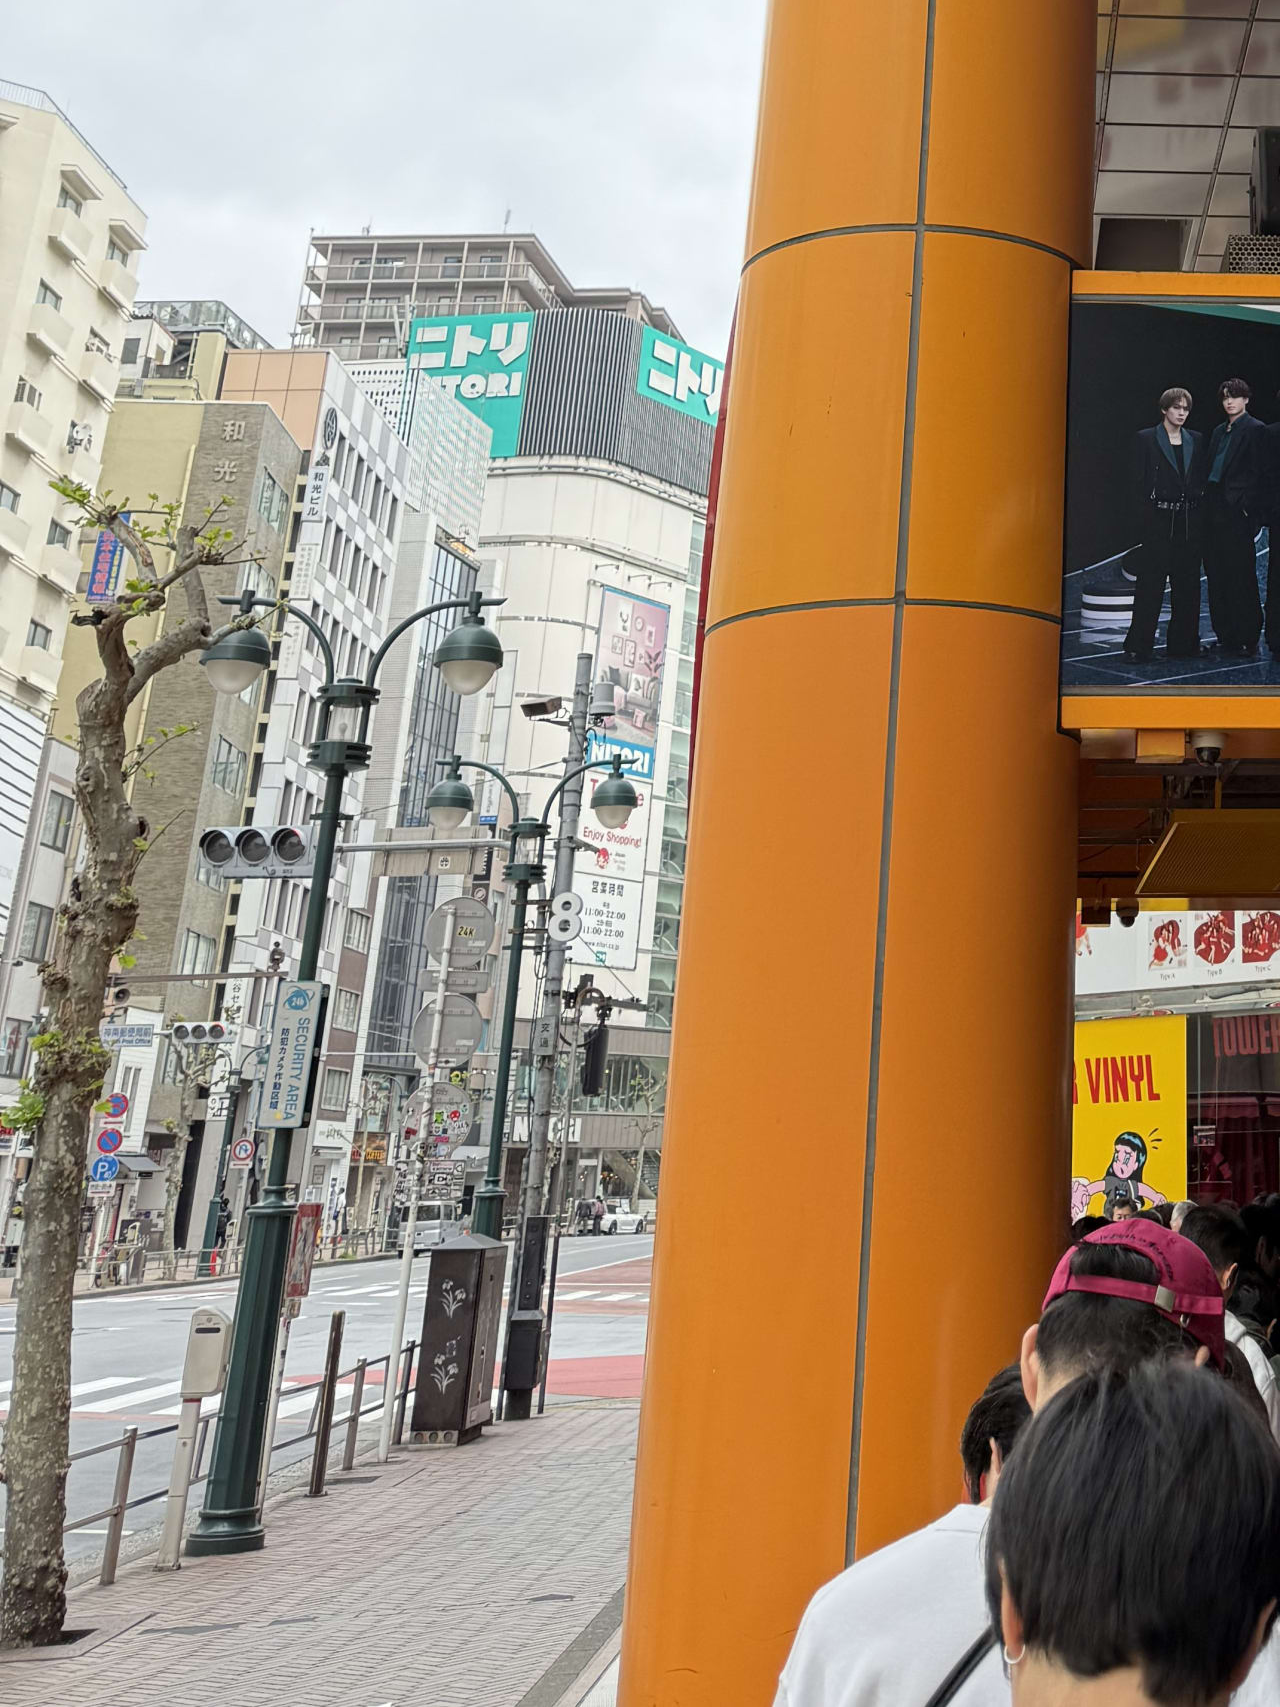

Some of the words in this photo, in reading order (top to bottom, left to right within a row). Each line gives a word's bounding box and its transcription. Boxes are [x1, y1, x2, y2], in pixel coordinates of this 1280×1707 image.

[409, 321, 529, 368] ニトリ
[429, 371, 522, 399] ITORI
[307, 472, 324, 516] 和光ビル
[583, 826, 605, 842] Enjoy
[606, 831, 642, 849] Shopping!
[592, 880, 624, 897] 営業時間
[550, 892, 583, 942] 8
[584, 907, 626, 920] 11:00-22:00
[457, 925, 475, 937] 24K
[583, 926, 624, 938] 11:00-22:00
[289, 1017, 310, 1081] SECURITY
[540, 1023, 550, 1048] 交通
[269, 1028, 290, 1110] 防犯カメラ作動区域
[1085, 1055, 1160, 1104] VINYL
[283, 1084, 300, 1121] AREA
